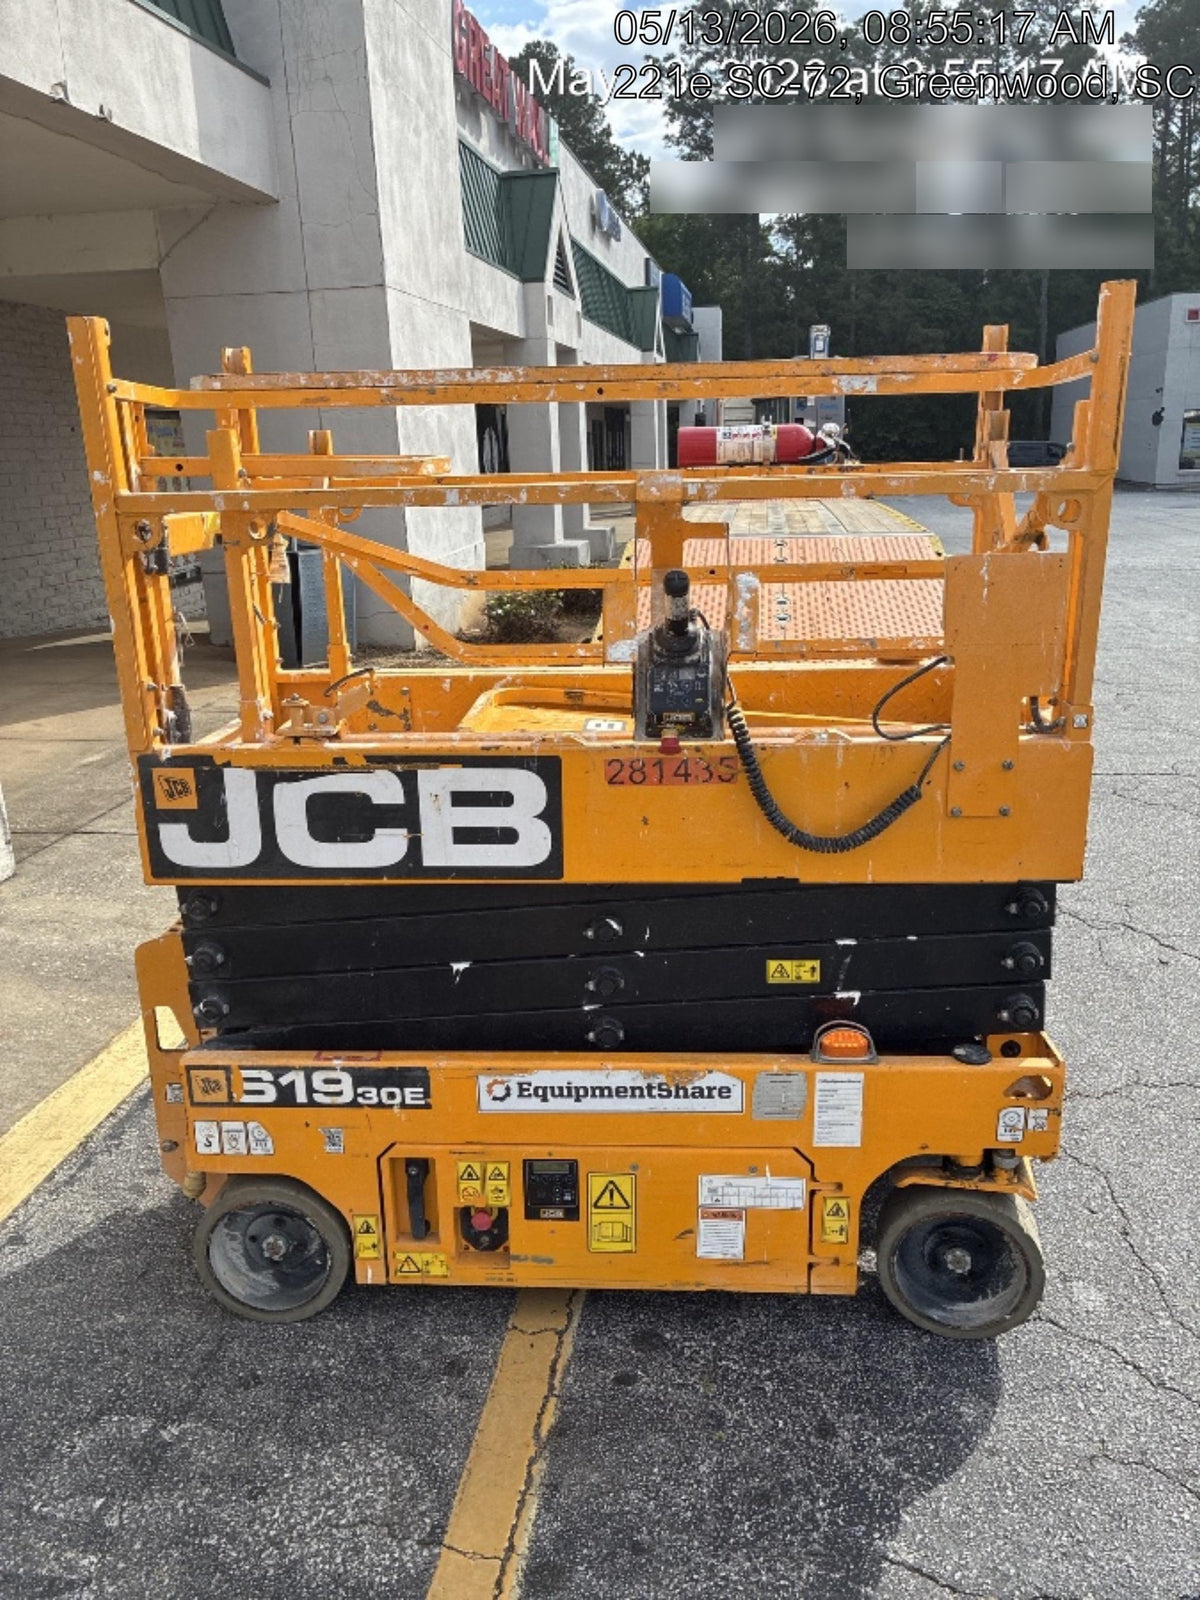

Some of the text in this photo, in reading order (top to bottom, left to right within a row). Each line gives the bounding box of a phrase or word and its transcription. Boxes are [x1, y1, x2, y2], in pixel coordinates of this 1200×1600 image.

[606, 756, 737, 785] 281435
[158, 766, 553, 869] JCB
[515, 1081, 733, 1103] EquipmentShare
